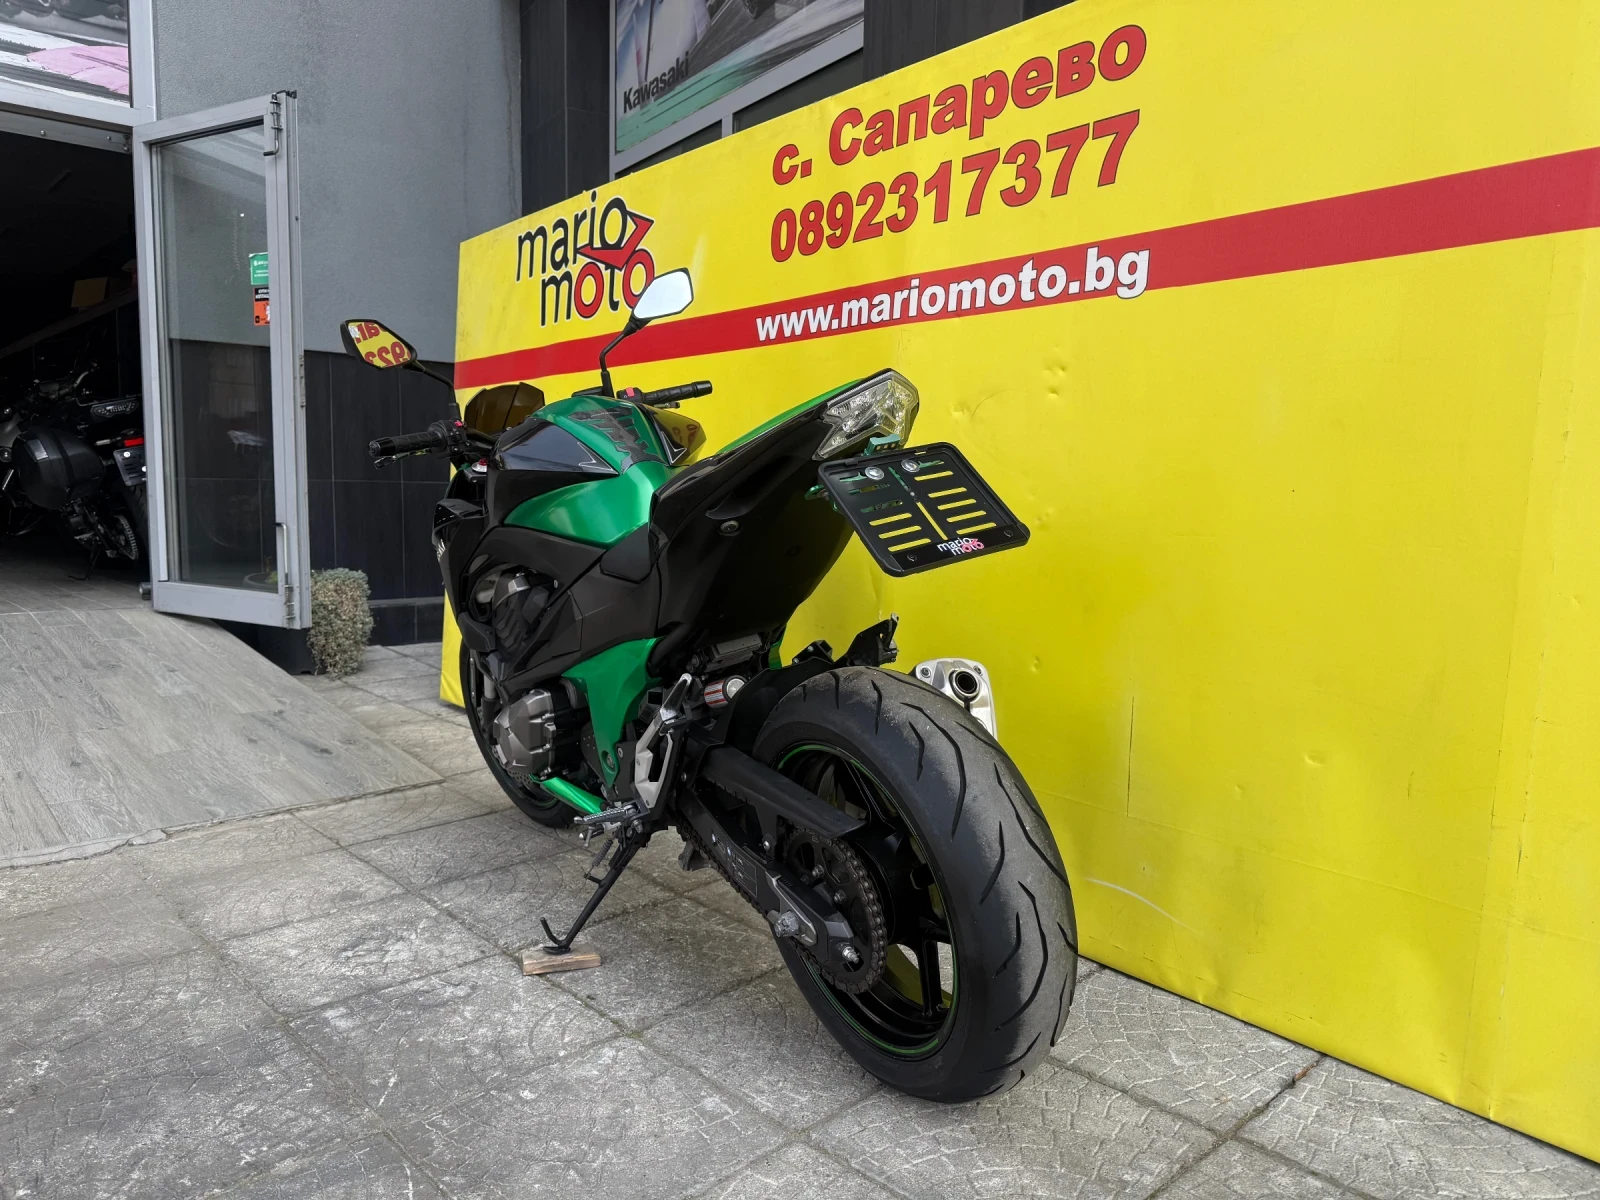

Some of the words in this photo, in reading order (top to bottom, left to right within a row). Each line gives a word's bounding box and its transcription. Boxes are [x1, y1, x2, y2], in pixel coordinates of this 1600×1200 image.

[623, 51, 689, 114] Kawasaki
[829, 24, 1147, 165] Сапарево
[770, 109, 1140, 263] 0892317377
[516, 190, 627, 282] mario
[540, 248, 655, 326] moto
[755, 246, 1151, 342] www.mariomoto.bg
[936, 537, 971, 552] mario
[950, 541, 985, 556] moto
